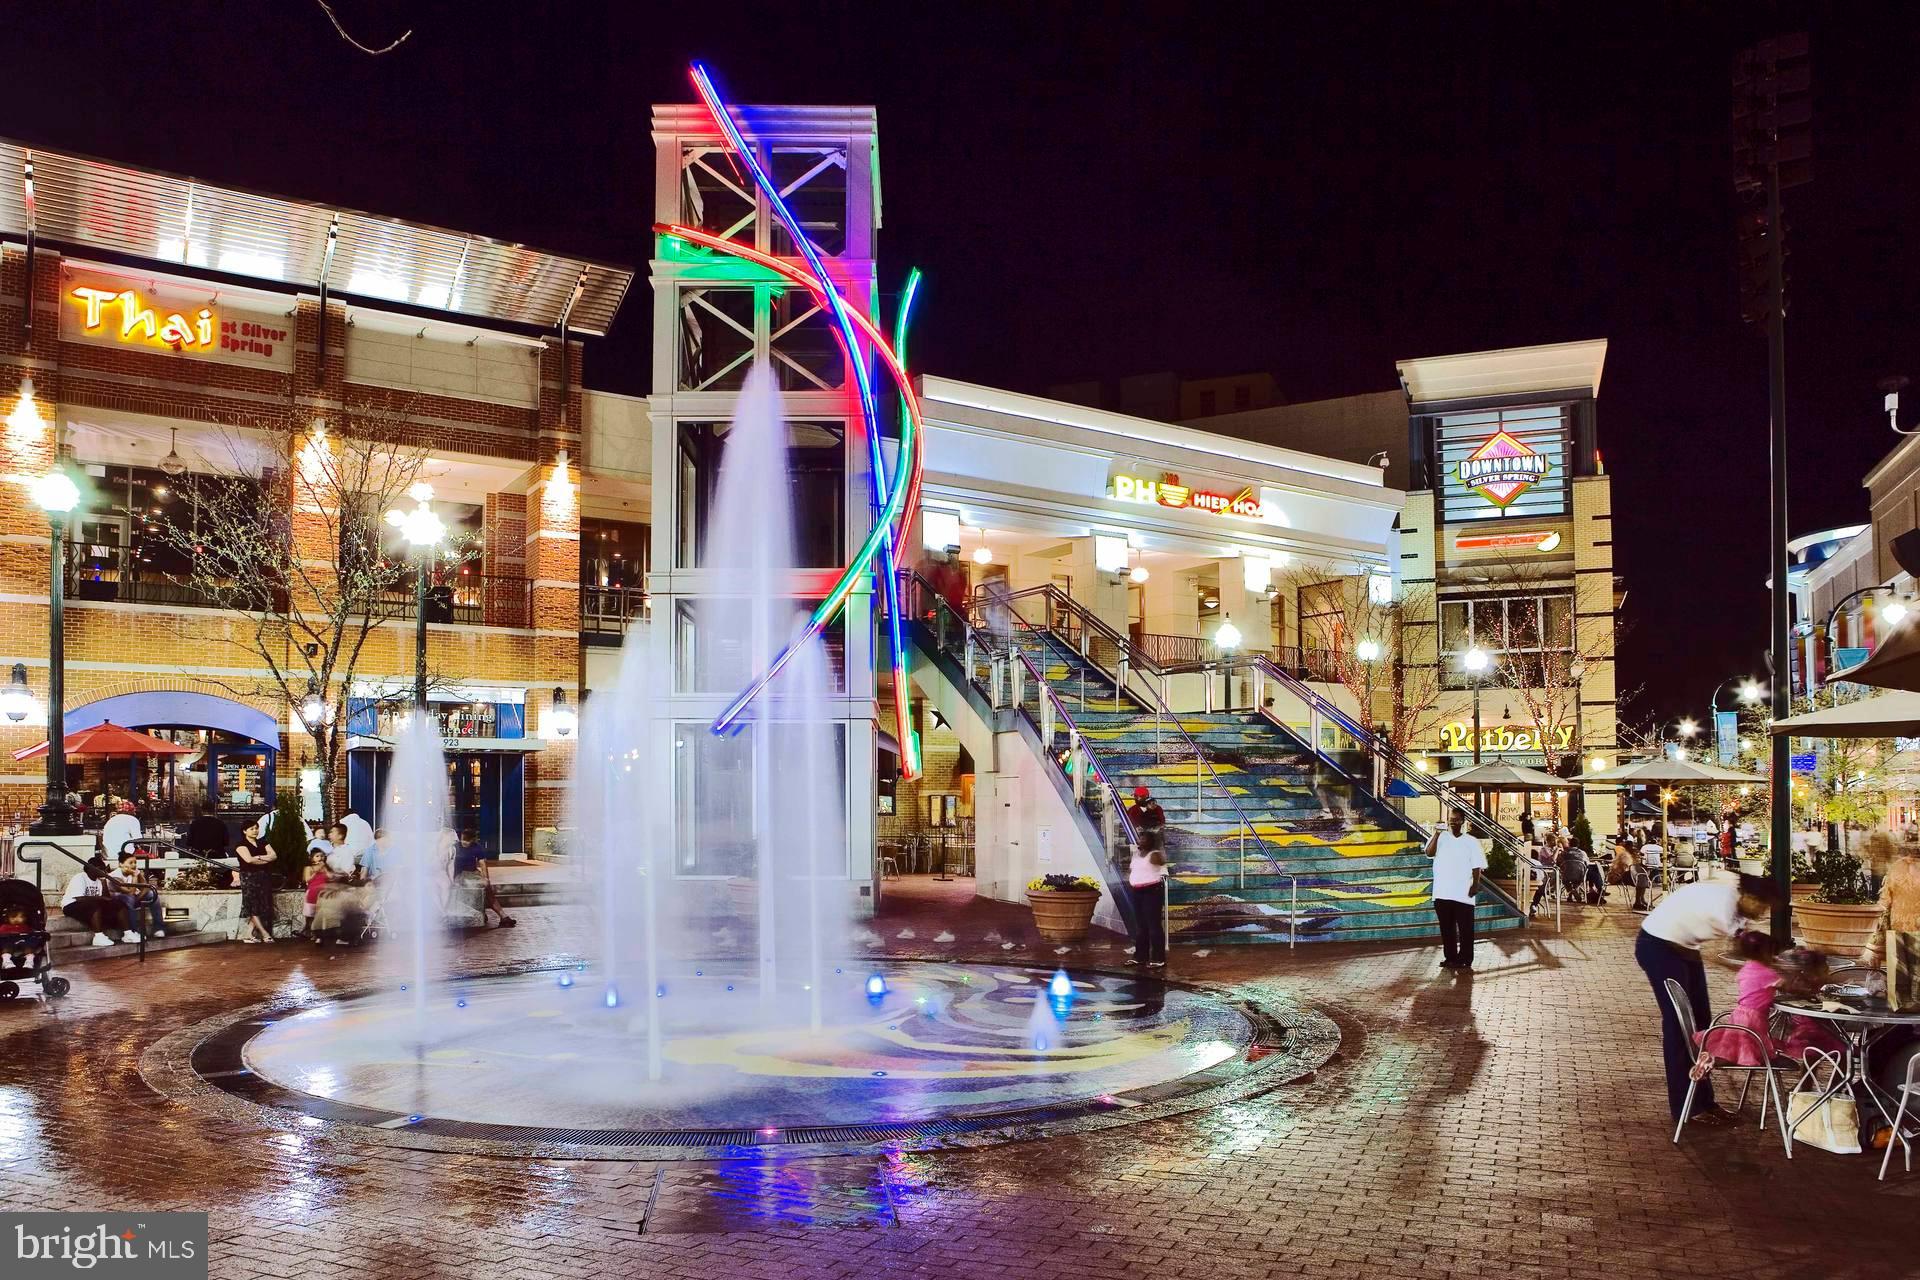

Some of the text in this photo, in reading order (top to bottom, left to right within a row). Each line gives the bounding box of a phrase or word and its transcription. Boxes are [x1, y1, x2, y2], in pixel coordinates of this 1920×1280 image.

[71, 287, 213, 347] Thai
[221, 321, 287, 341] at Silver
[221, 335, 273, 357] Spring
[1460, 455, 1545, 479] DOWNTOWN
[1470, 473, 1536, 487] SILVER SPRING
[437, 725, 478, 735] rience.
[443, 738, 460, 747] 923
[1519, 757, 1558, 766] WOR
